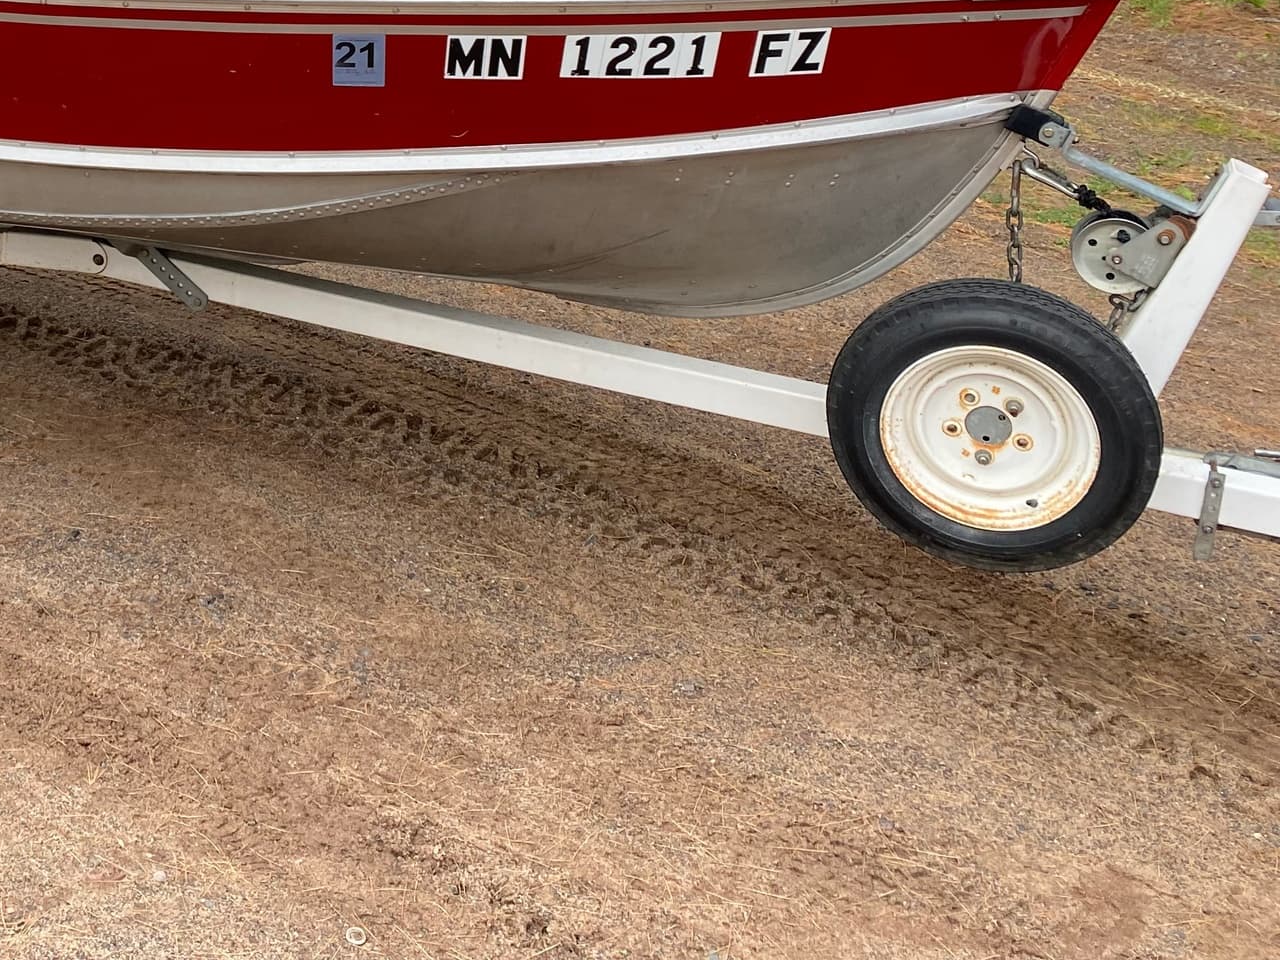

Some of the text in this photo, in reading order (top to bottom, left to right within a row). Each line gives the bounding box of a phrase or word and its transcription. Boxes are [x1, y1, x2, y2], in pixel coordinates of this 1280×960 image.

[334, 41, 376, 69] 21
[446, 31, 827, 77] MN 1221 FZ
